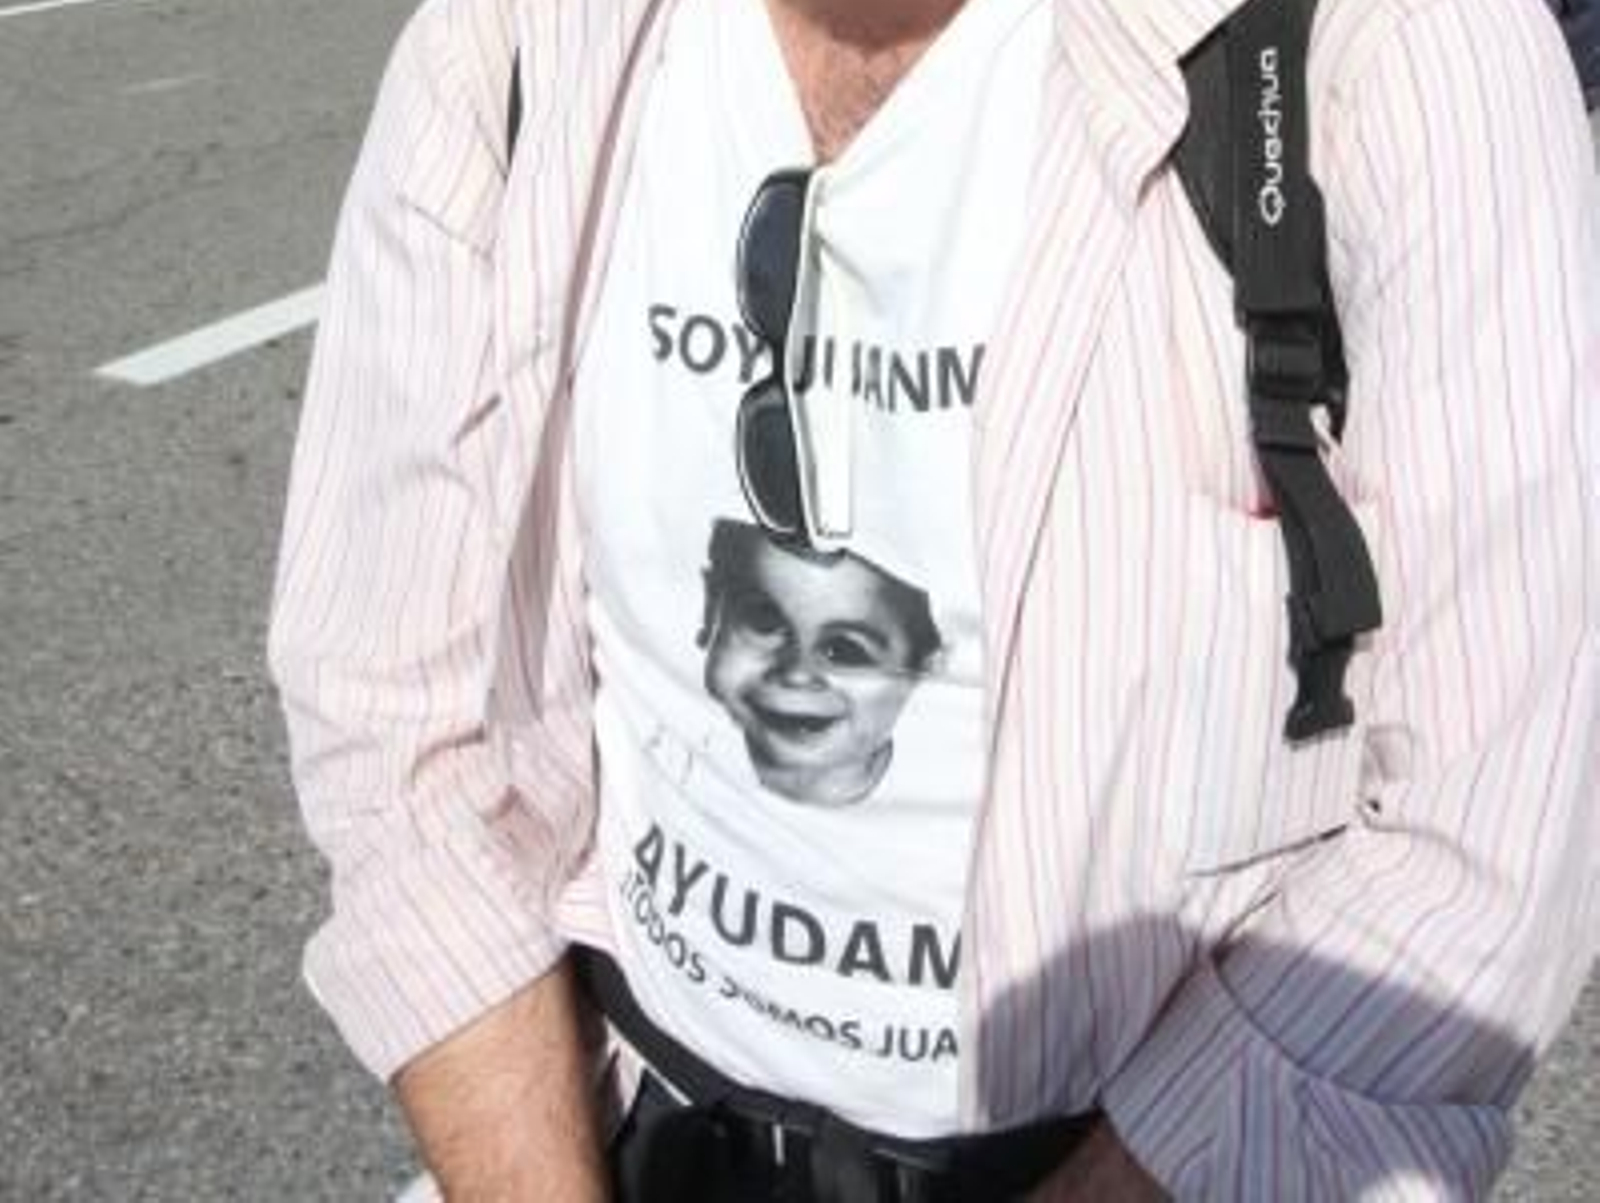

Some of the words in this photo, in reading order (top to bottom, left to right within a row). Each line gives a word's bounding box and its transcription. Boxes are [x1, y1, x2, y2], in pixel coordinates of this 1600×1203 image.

[1257, 45, 1287, 227] Quechua
[648, 303, 767, 384] SOY
[875, 1025, 959, 1062] JUA
